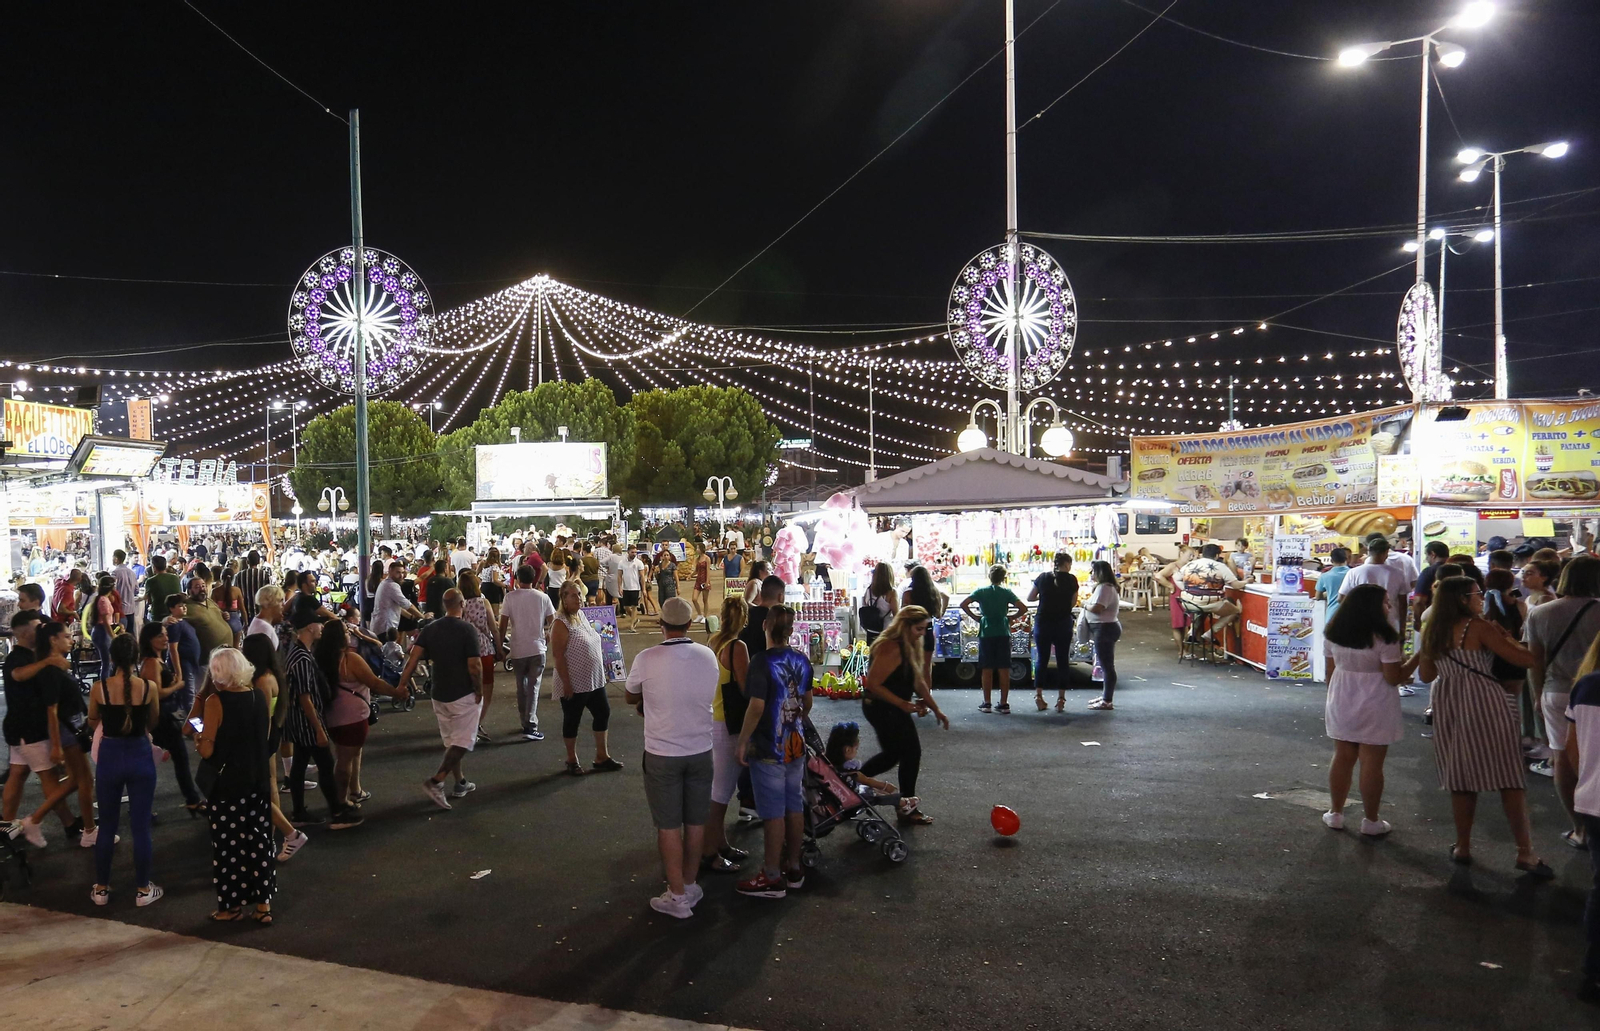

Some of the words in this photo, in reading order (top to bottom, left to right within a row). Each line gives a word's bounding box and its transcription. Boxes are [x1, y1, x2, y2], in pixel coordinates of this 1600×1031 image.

[1554, 412, 1567, 427] EL
[5, 402, 91, 450] BAGUETTERIA
[1178, 440, 1201, 454] HOT
[1201, 437, 1228, 453] DOG
[1226, 431, 1286, 451] PERRITOS
[1288, 430, 1307, 445] AL
[1304, 422, 1354, 442] VAPOR
[1531, 432, 1568, 441] PERRITO
[28, 441, 41, 454] EL
[43, 436, 75, 456] LOBO
[1301, 444, 1327, 454] MENU
[1560, 443, 1591, 451] PATATAS
[1265, 449, 1290, 457] MENU
[1177, 456, 1212, 465] OFERTA
[1492, 457, 1516, 465] BEBIDA
[1297, 491, 1336, 506] Bebida
[1345, 492, 1377, 504] Bebida
[1228, 502, 1257, 512] Bebida
